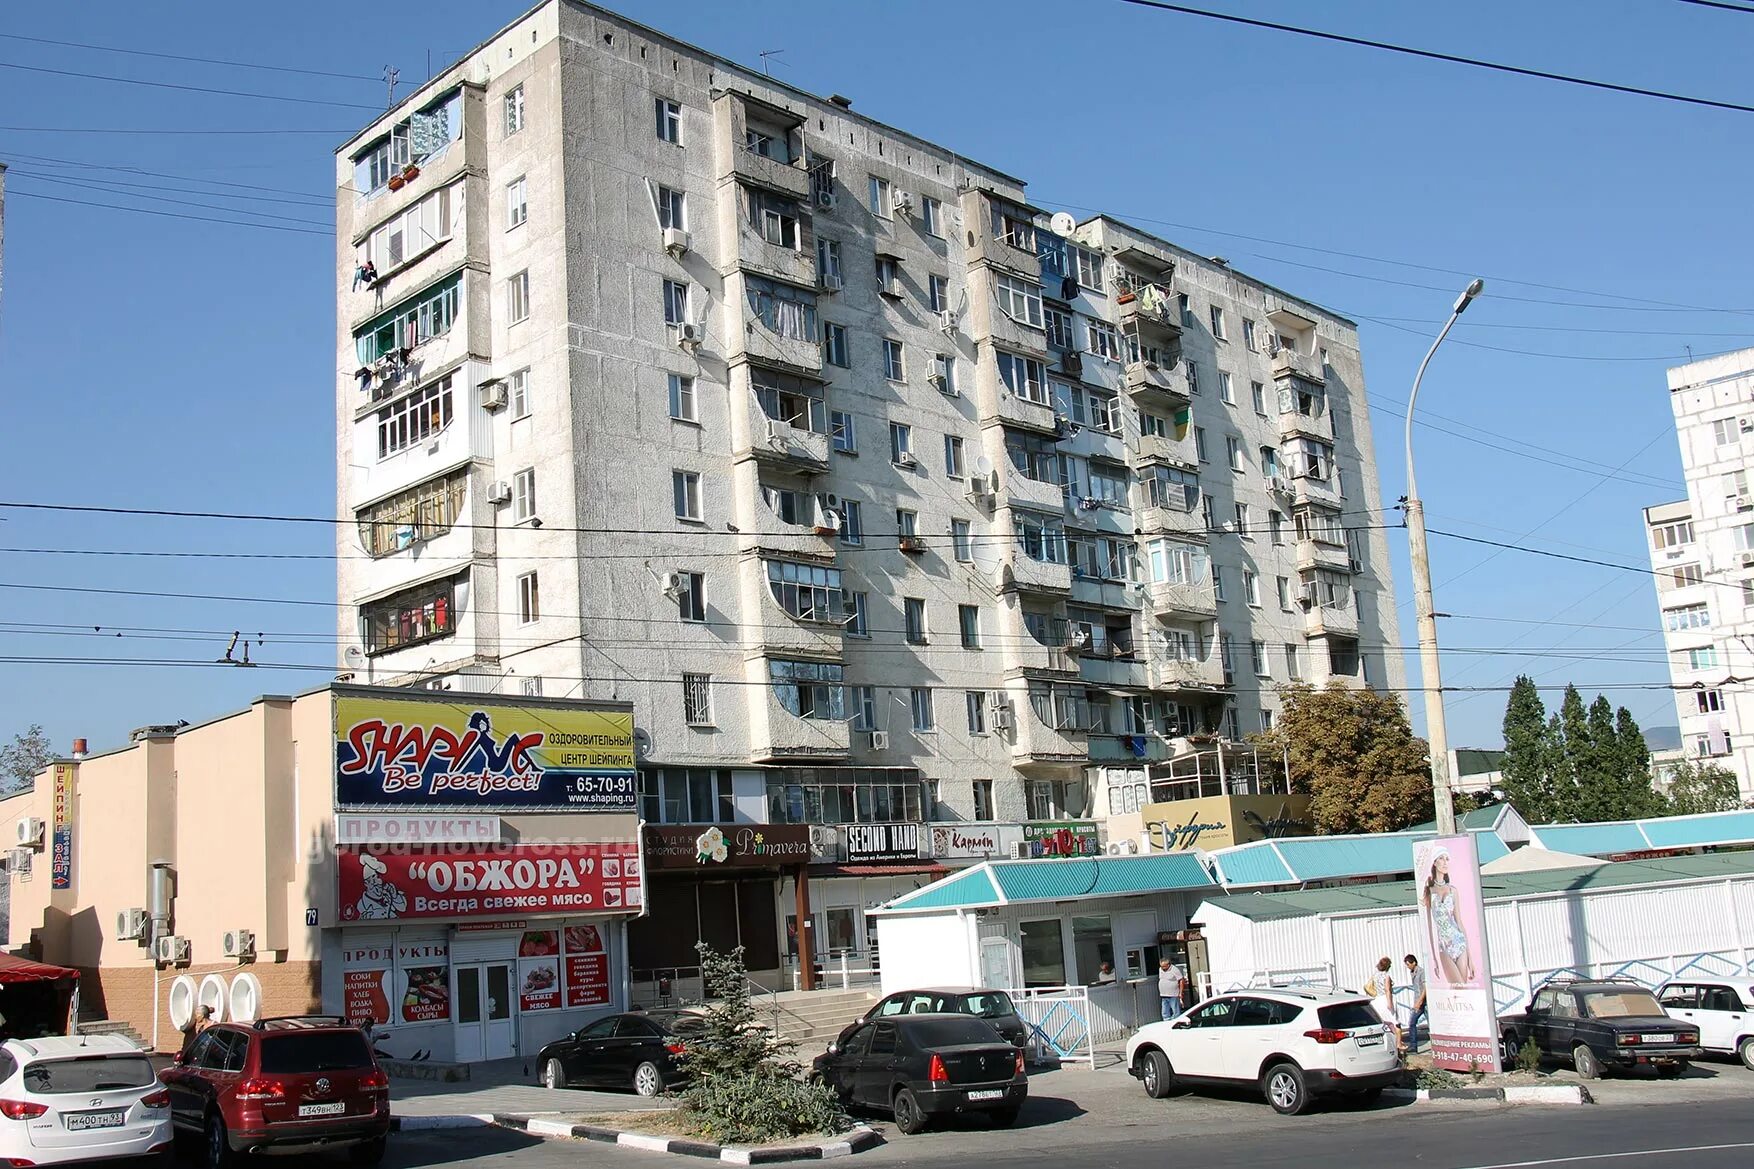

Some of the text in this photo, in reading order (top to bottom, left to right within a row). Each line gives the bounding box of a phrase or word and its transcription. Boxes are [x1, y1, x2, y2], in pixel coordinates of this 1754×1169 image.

[549, 733, 632, 746] ОЗДОРОВИТЕЛЬНЫЙ
[561, 752, 632, 766] ЦЕНТР ШЕЙПИНГА
[386, 768, 541, 795] Be perfect!
[577, 777, 632, 792] 65-70-91
[568, 794, 634, 804] www.shaping.ru
[346, 818, 494, 841] ПРОДУКТЫ
[736, 828, 807, 857] Primavera
[849, 825, 916, 853] SECOND HAND
[415, 893, 593, 912] Всегда свежее мясо
[307, 909, 316, 924] 79
[351, 973, 371, 981] СОКИ
[345, 982, 378, 990] НАПИТКИ
[353, 991, 370, 999] ХЛЕБ
[525, 993, 554, 1001] СВЕЖЕЕ
[350, 1000, 373, 1008] ВОДКА
[411, 1004, 444, 1013] КОЛБАСЫ
[529, 1002, 550, 1010] МЯСО
[1461, 1041, 1491, 1049] РЕКЛАМЫ
